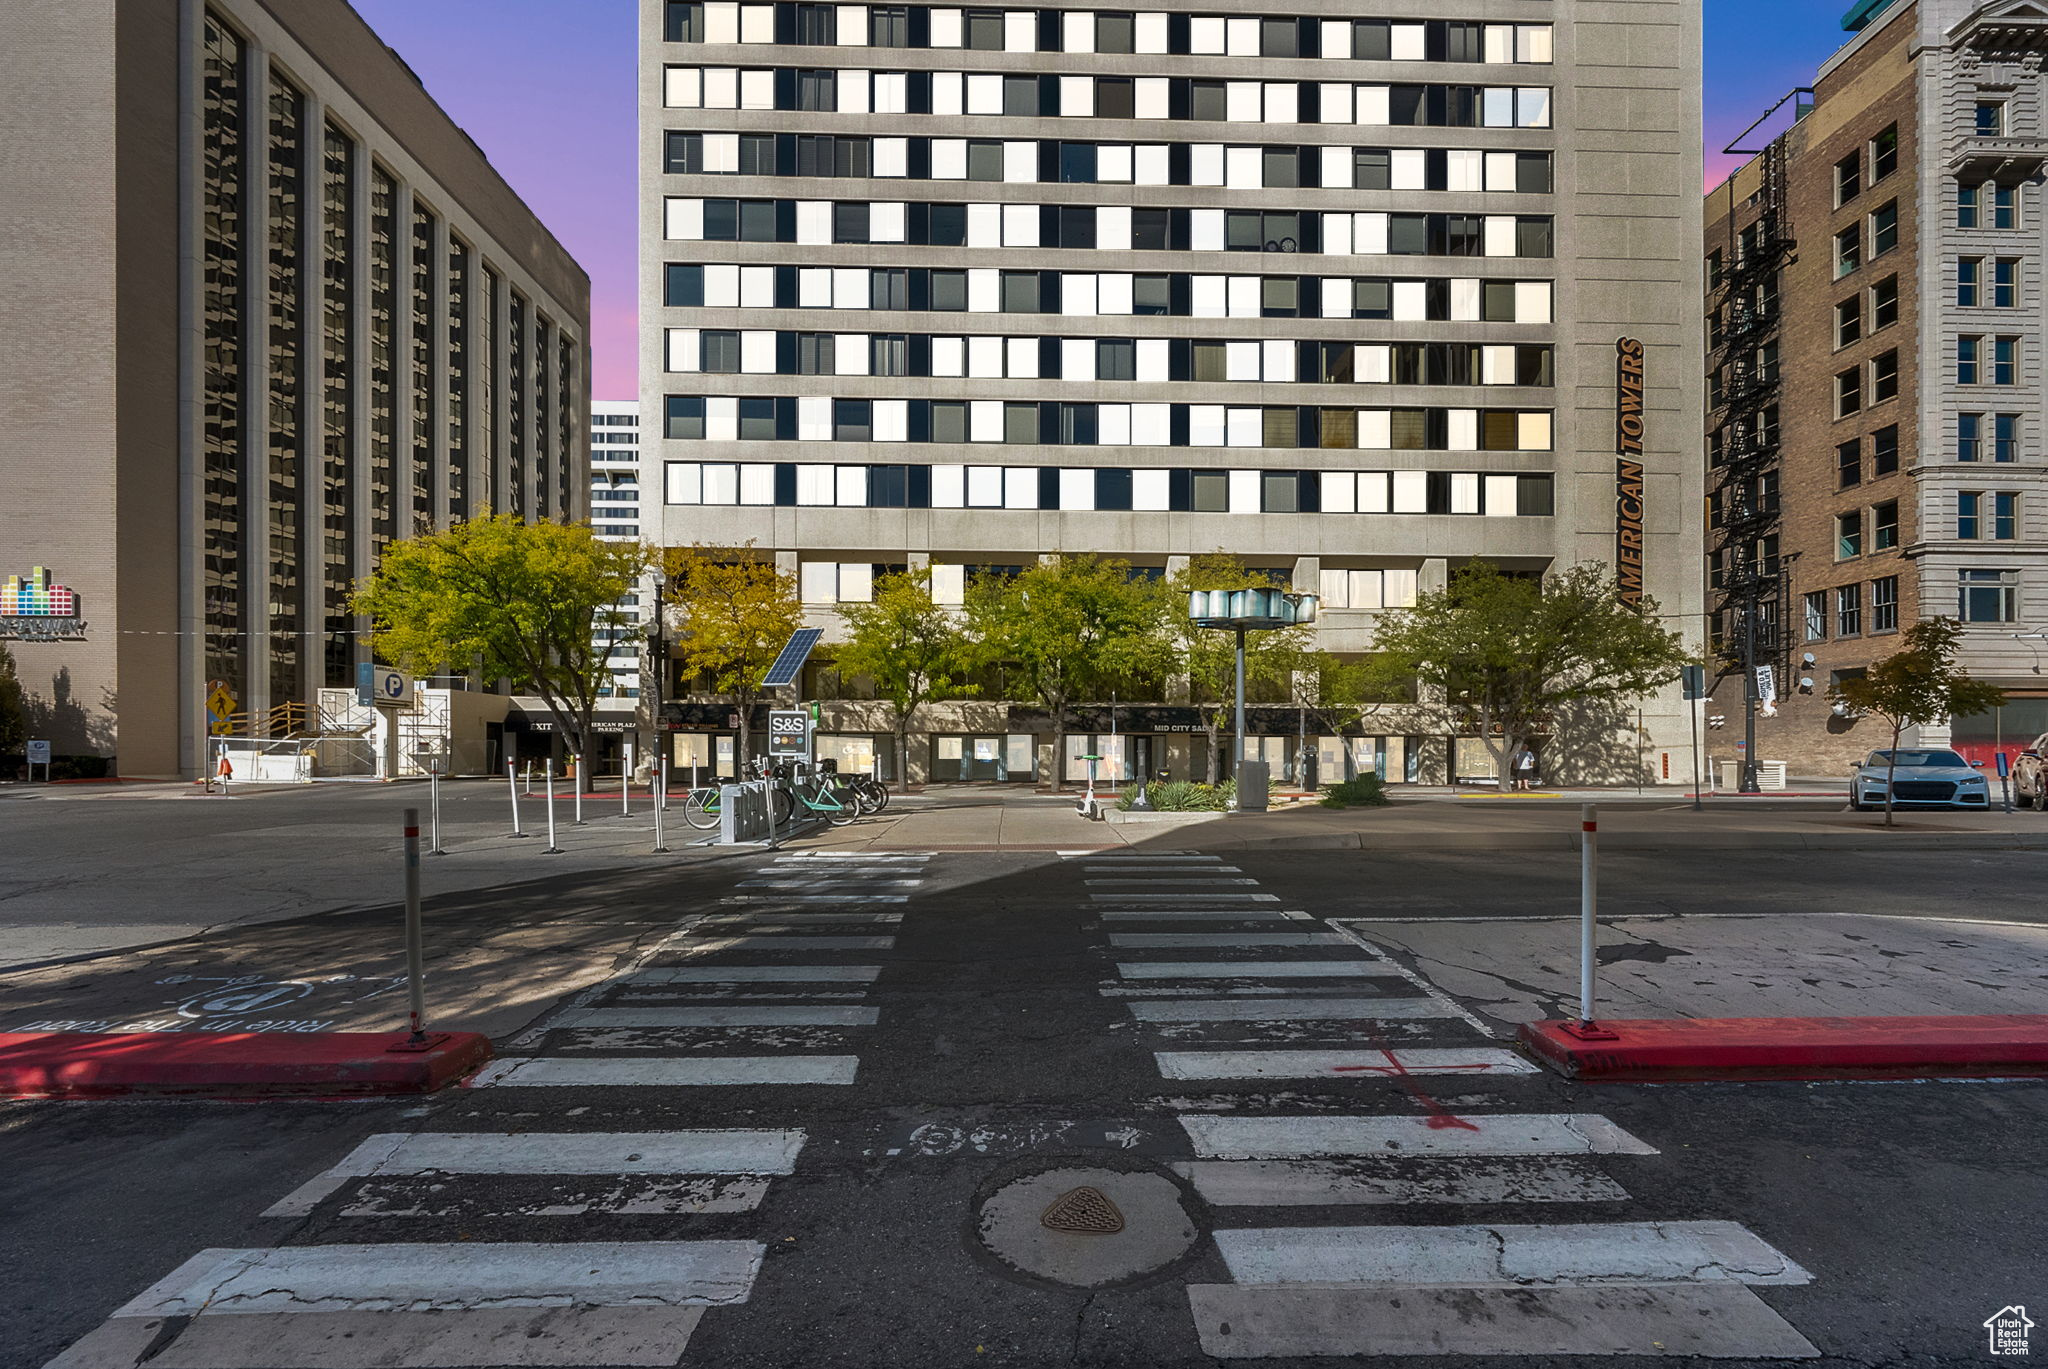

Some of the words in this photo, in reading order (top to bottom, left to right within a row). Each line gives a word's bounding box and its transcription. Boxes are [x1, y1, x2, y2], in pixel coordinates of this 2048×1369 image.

[1617, 338, 1644, 455] TOWERS
[1618, 460, 1644, 613] AMERICAN
[772, 718, 804, 731] S&S
[246, 1020, 334, 1033] Ride
